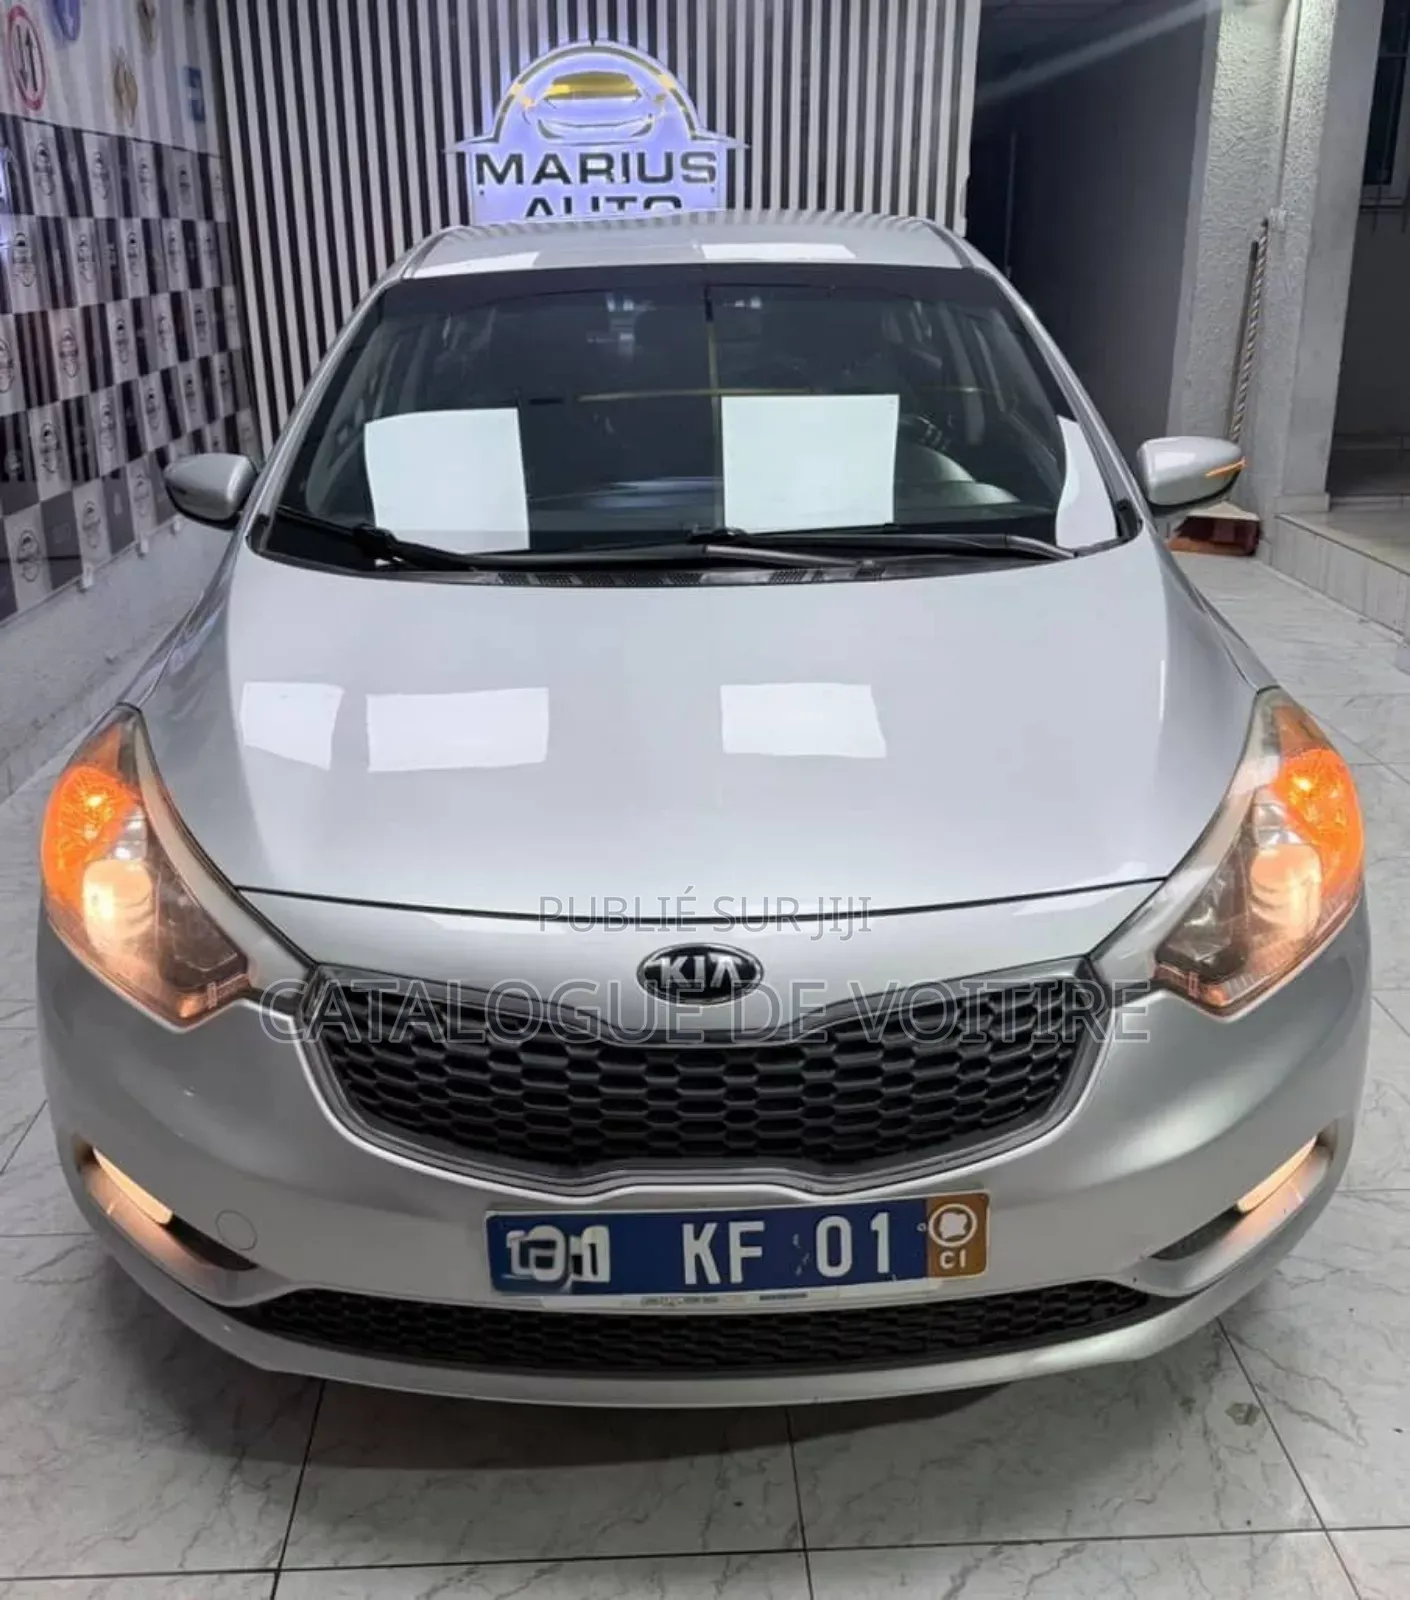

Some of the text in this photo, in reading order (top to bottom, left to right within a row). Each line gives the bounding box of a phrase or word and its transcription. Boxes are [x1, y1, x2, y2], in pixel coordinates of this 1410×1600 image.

[475, 151, 717, 185] MARIUS
[660, 951, 743, 989] KIA
[682, 1220, 765, 1285] KF
[815, 1211, 890, 1278] 01
